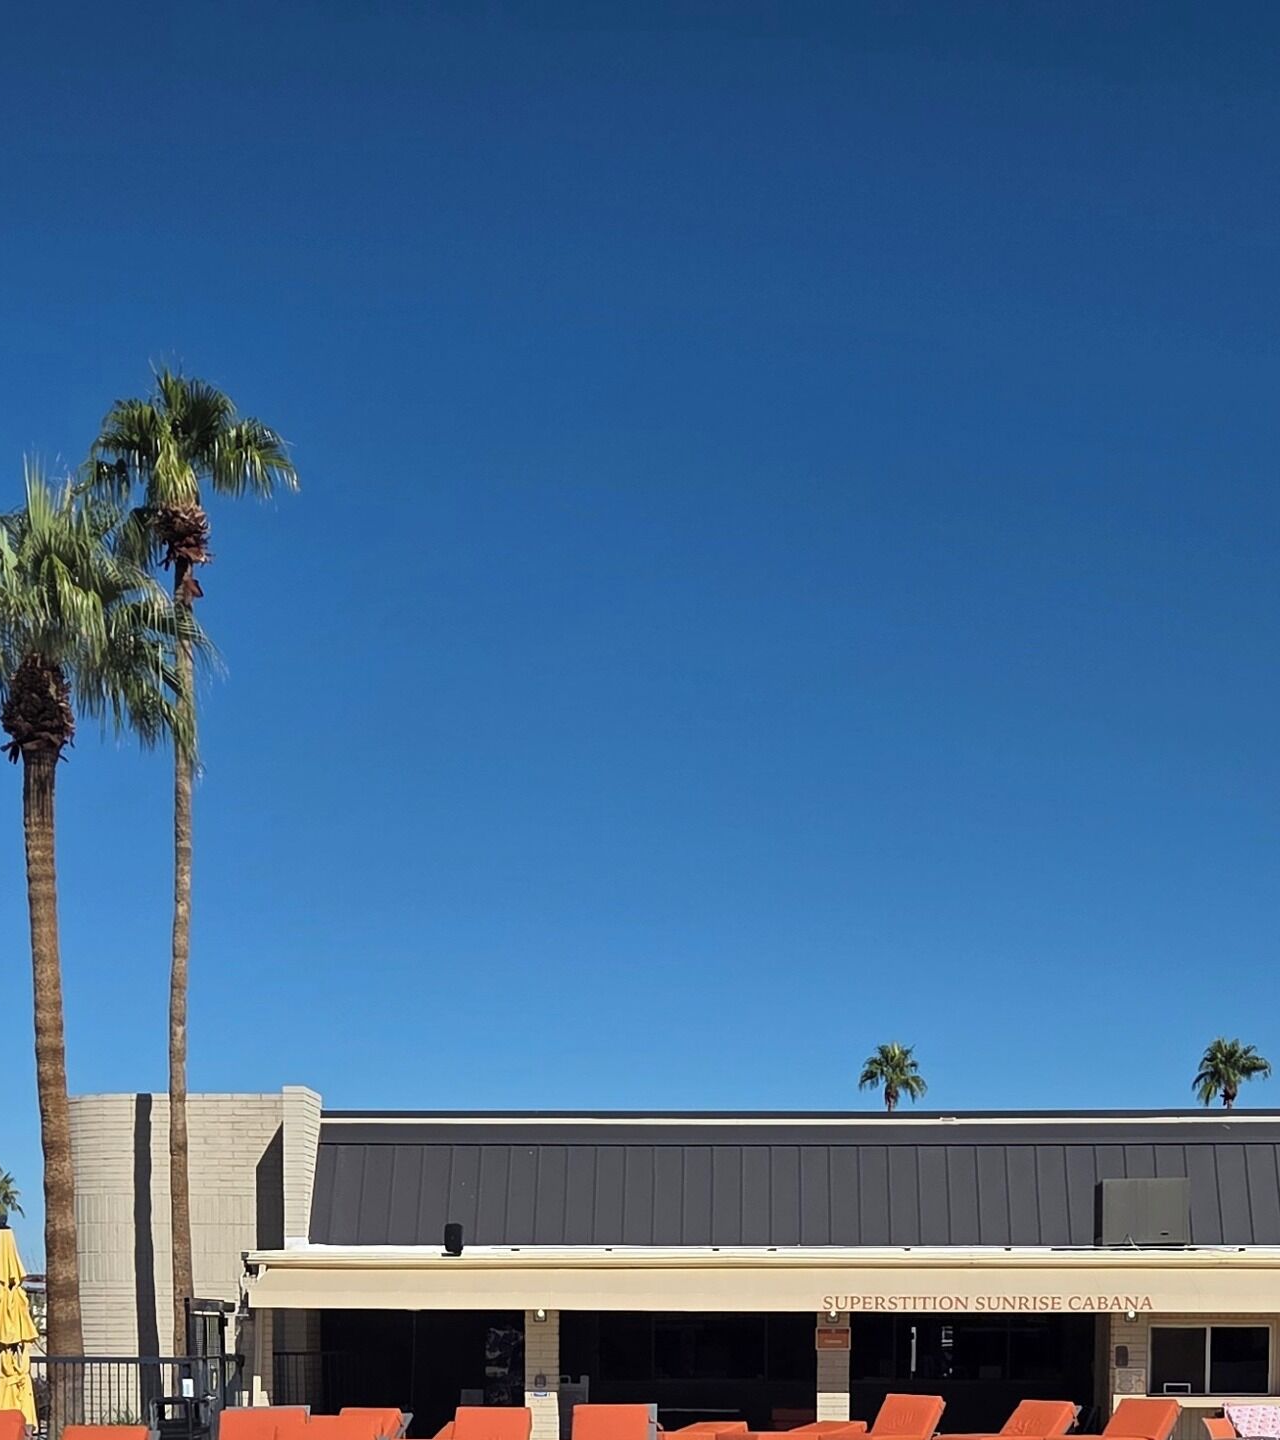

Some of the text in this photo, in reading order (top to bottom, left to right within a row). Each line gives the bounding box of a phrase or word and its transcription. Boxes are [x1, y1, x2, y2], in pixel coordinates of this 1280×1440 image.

[822, 1296, 1154, 1310] SUPERSTITION SUNRISE CABANA
